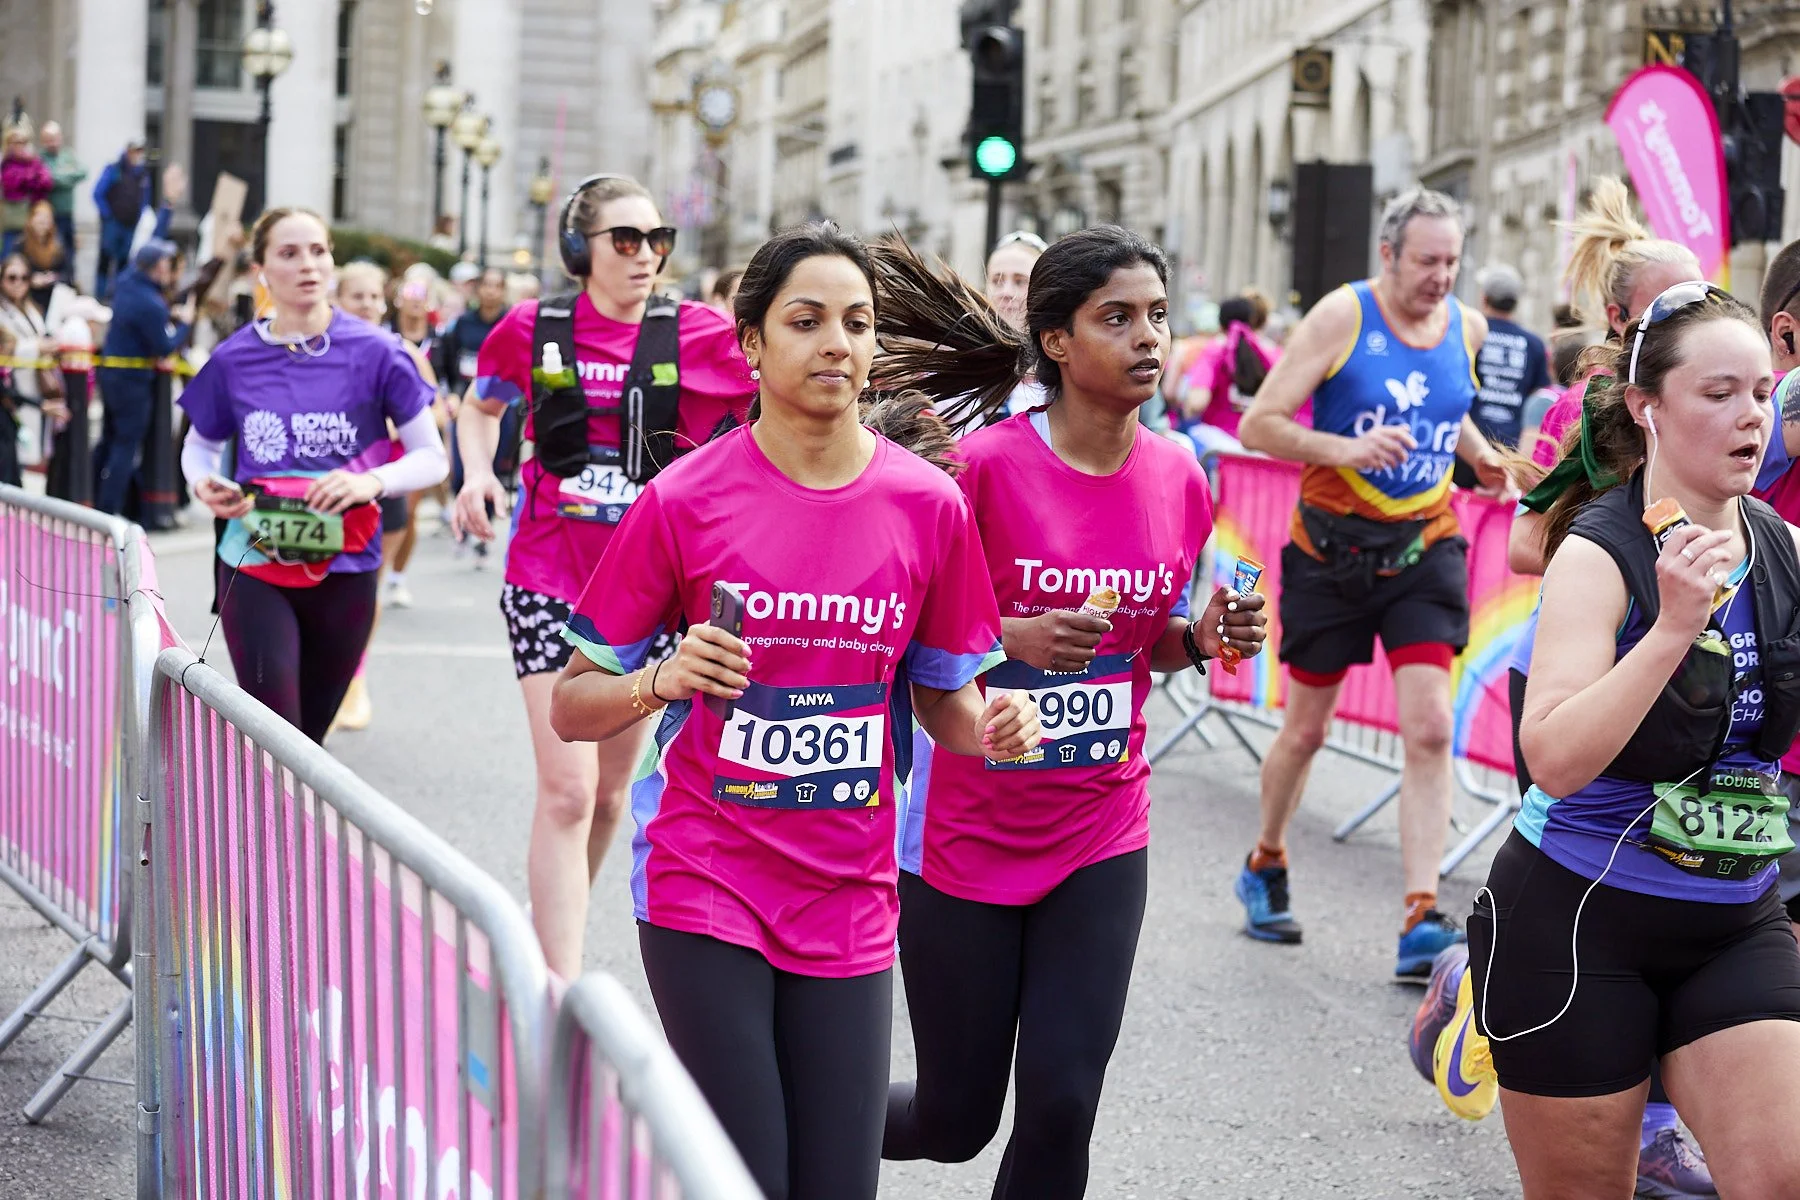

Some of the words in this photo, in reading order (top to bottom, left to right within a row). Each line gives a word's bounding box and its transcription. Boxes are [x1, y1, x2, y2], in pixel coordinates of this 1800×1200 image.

[291, 411, 352, 431] ROYAL
[1014, 558, 1174, 603] Tommy's
[1012, 602, 1030, 614] The
[1117, 605, 1137, 618] aby
[745, 636, 809, 648] pregnancy
[813, 637, 837, 649] and
[838, 638, 868, 653] baby
[1730, 632, 1757, 649] GR
[1733, 651, 1759, 668] OR
[788, 693, 835, 707] TANYA
[1028, 688, 1114, 729] 990
[737, 719, 869, 766] 10361
[1715, 774, 1760, 789] LOUISE
[1680, 795, 1774, 843] 8122
